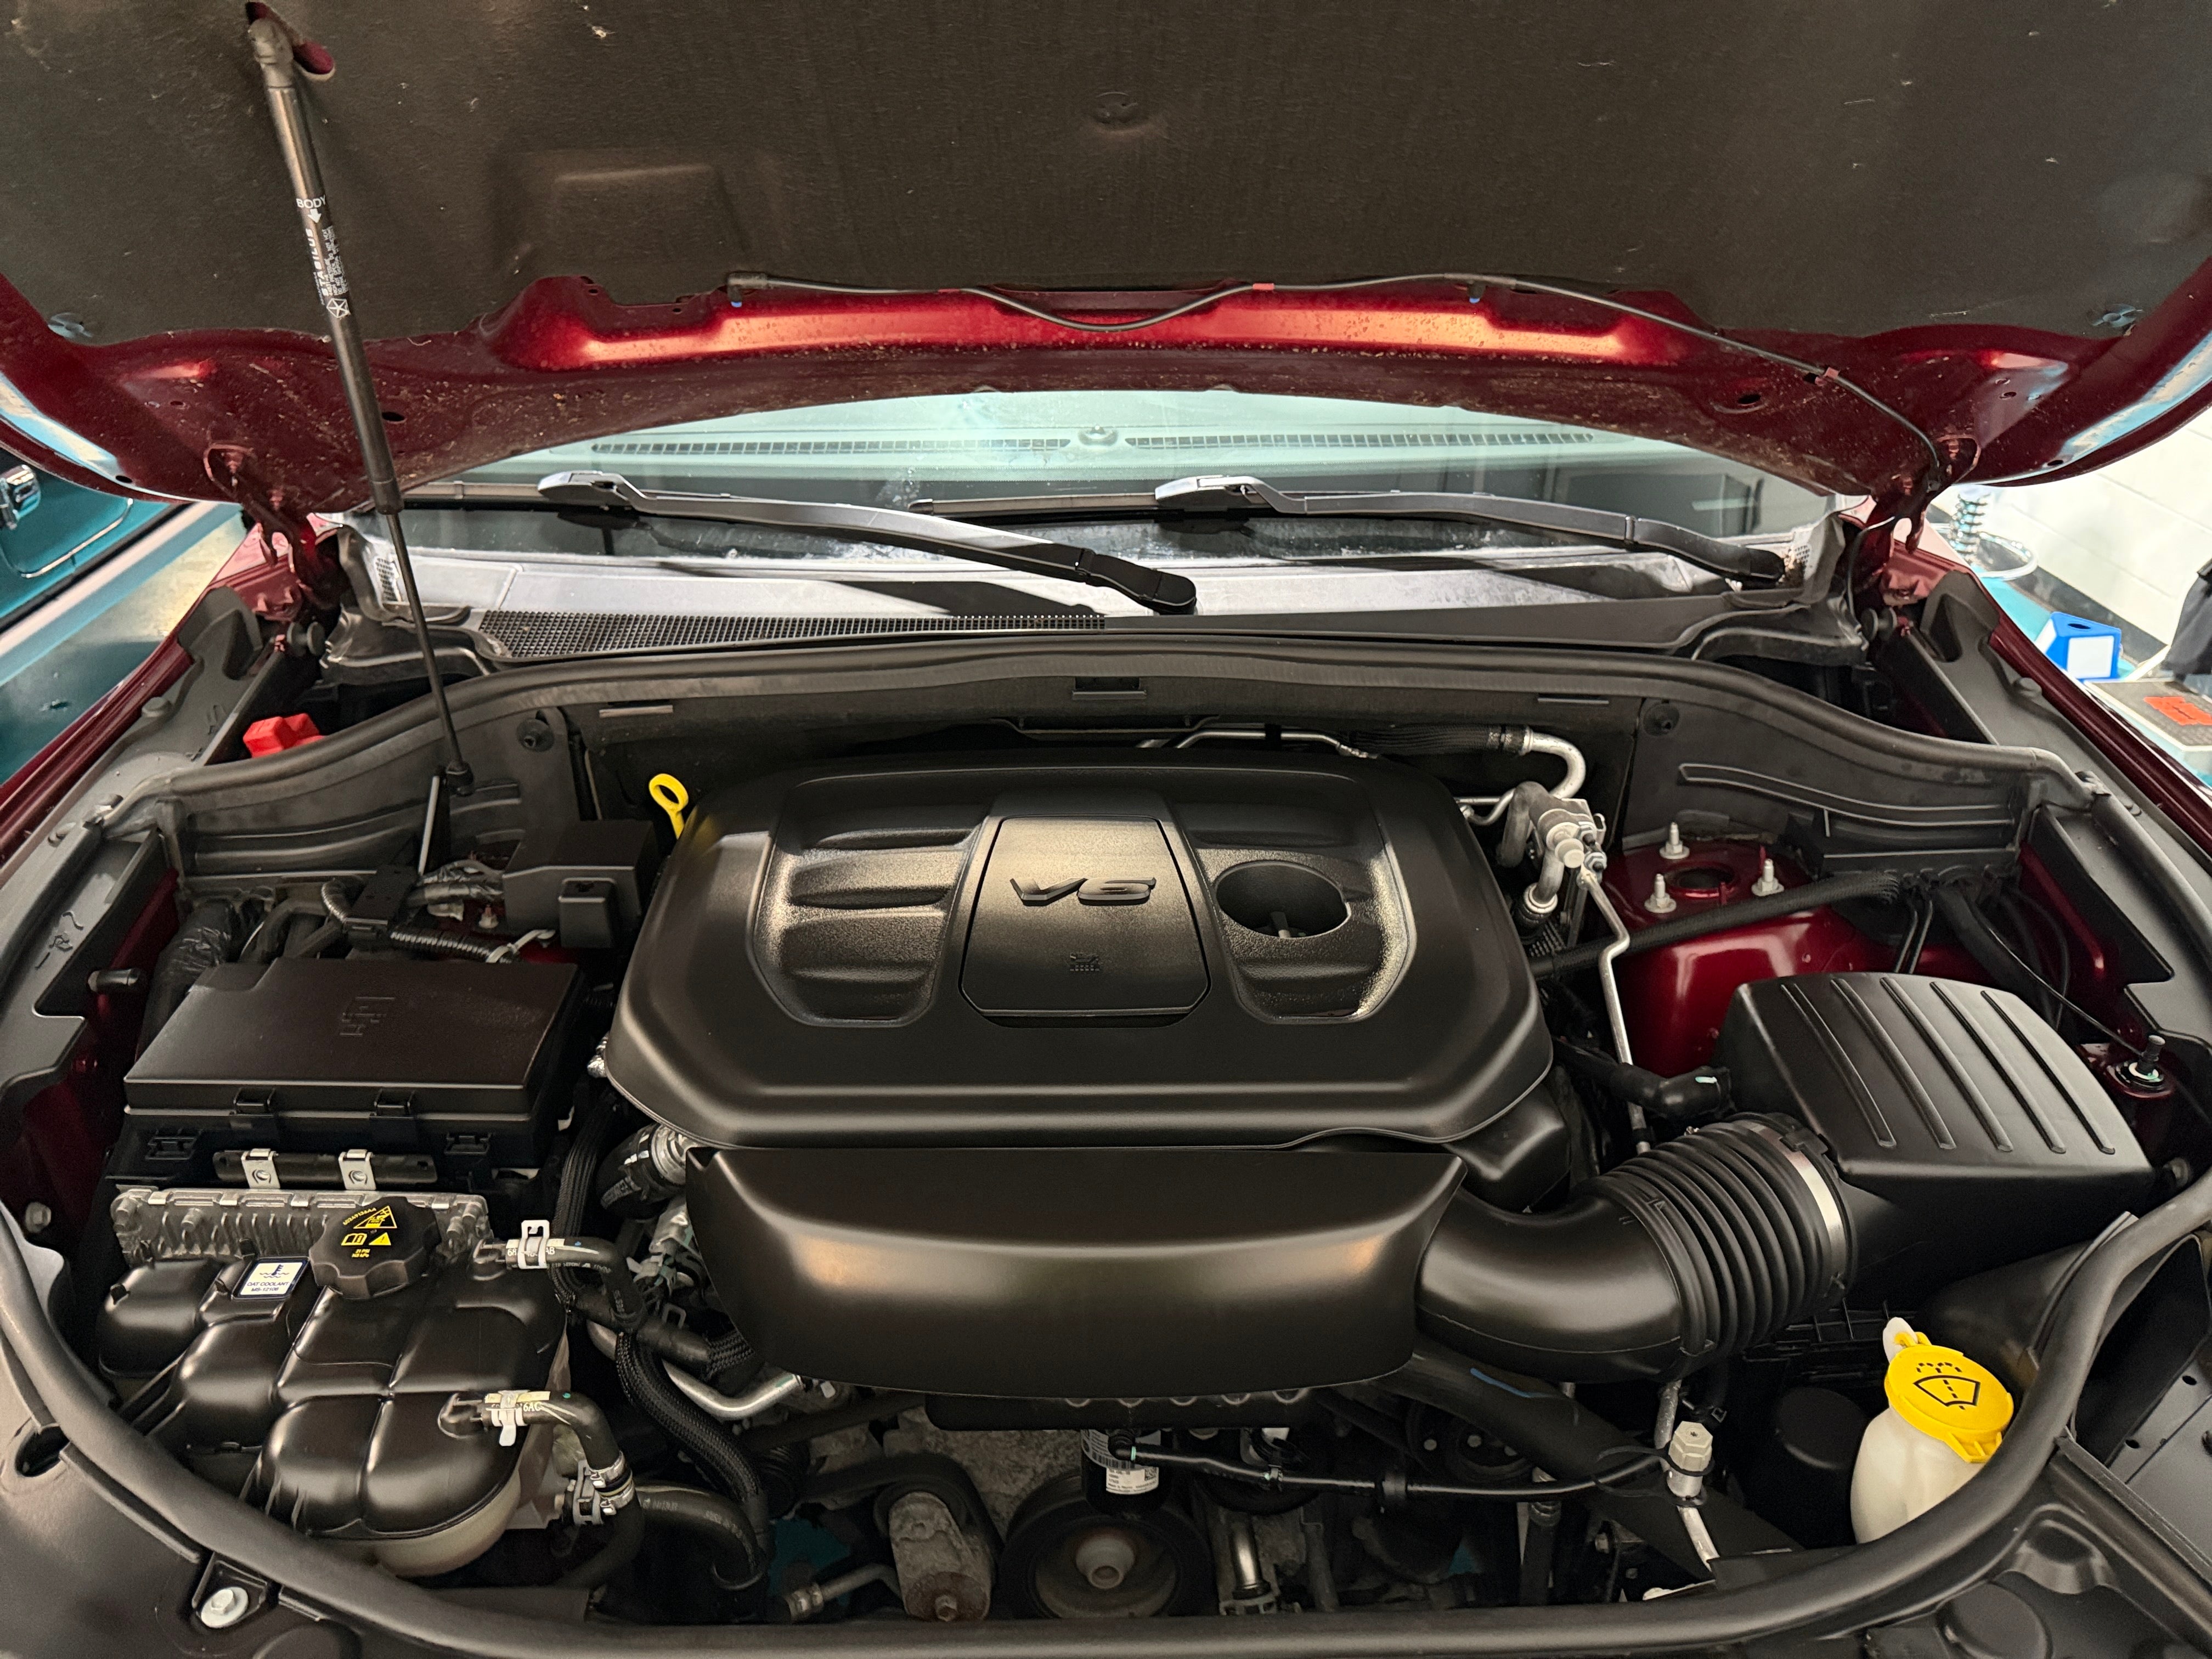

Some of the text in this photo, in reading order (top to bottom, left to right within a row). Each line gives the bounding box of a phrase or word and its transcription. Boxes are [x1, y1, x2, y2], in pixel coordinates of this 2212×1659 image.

[296, 194, 326, 208] BODY
[305, 228, 329, 297] STABILUS
[1009, 877, 1156, 906] V6
